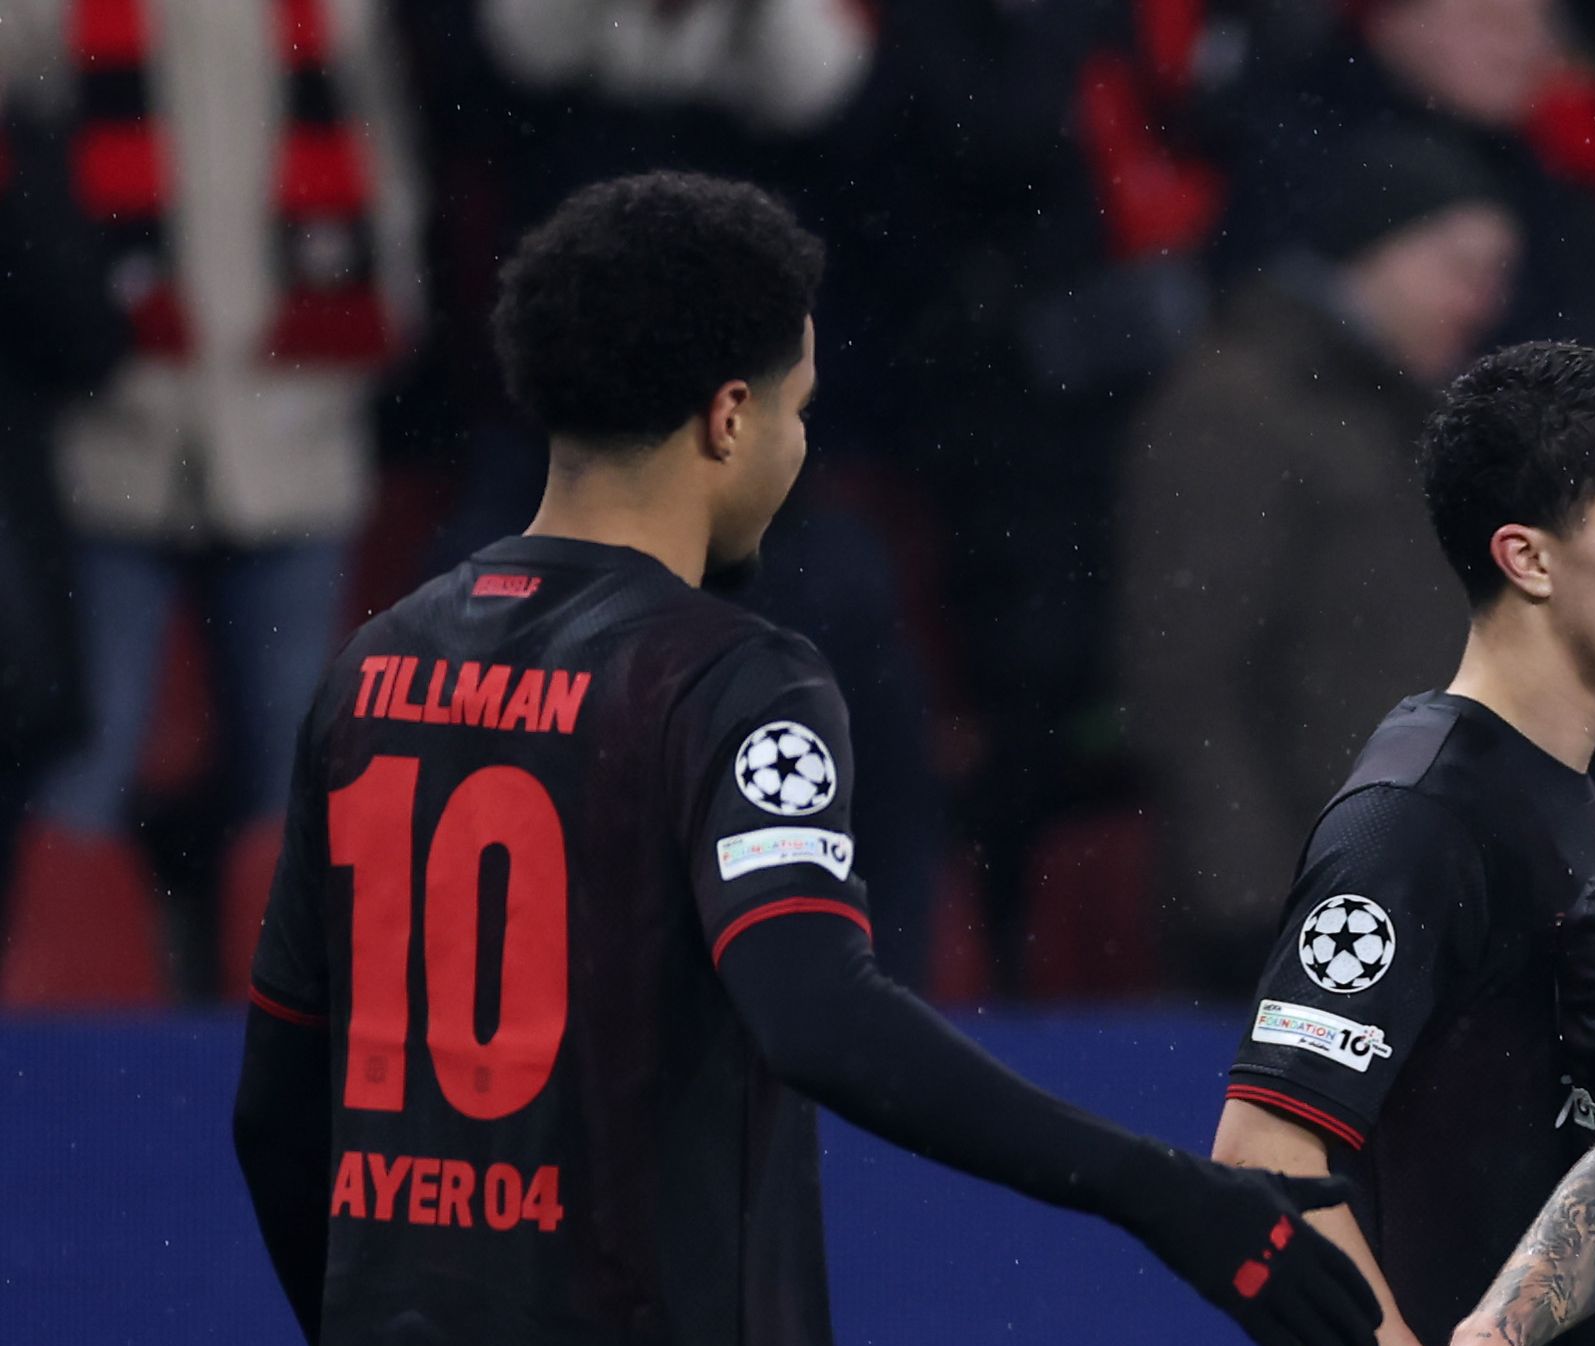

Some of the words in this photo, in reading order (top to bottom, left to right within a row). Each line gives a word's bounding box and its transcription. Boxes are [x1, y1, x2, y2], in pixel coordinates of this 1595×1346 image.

[353, 655, 592, 734] TILLMAN
[328, 755, 568, 1120] 10
[330, 1150, 475, 1229] AYER
[484, 1162, 565, 1232] 04
